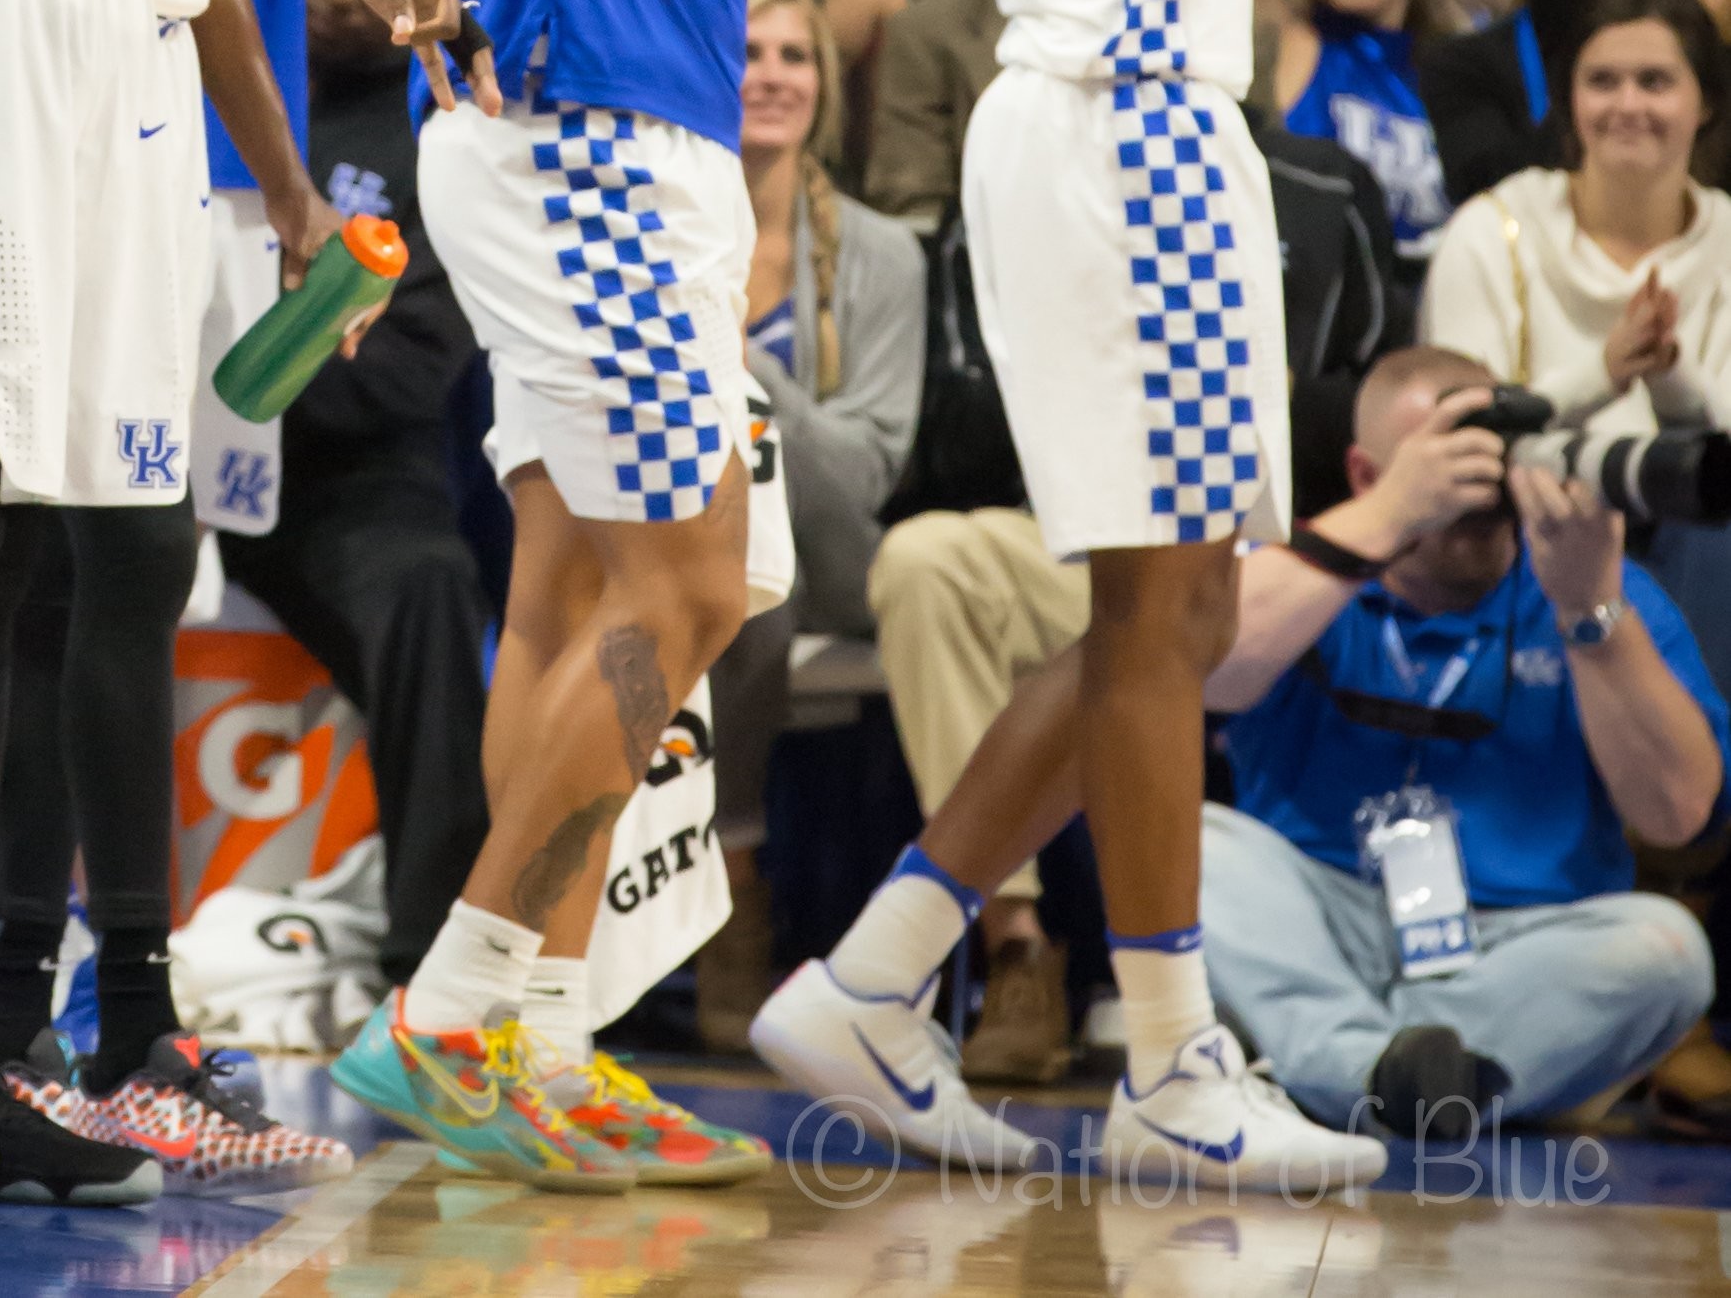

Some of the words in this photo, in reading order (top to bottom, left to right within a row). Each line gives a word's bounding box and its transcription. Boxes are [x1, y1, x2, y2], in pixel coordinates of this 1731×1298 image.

[117, 419, 182, 488] UK
[218, 449, 271, 518] UK
[198, 704, 304, 821] G
[607, 814, 714, 915] GAT
